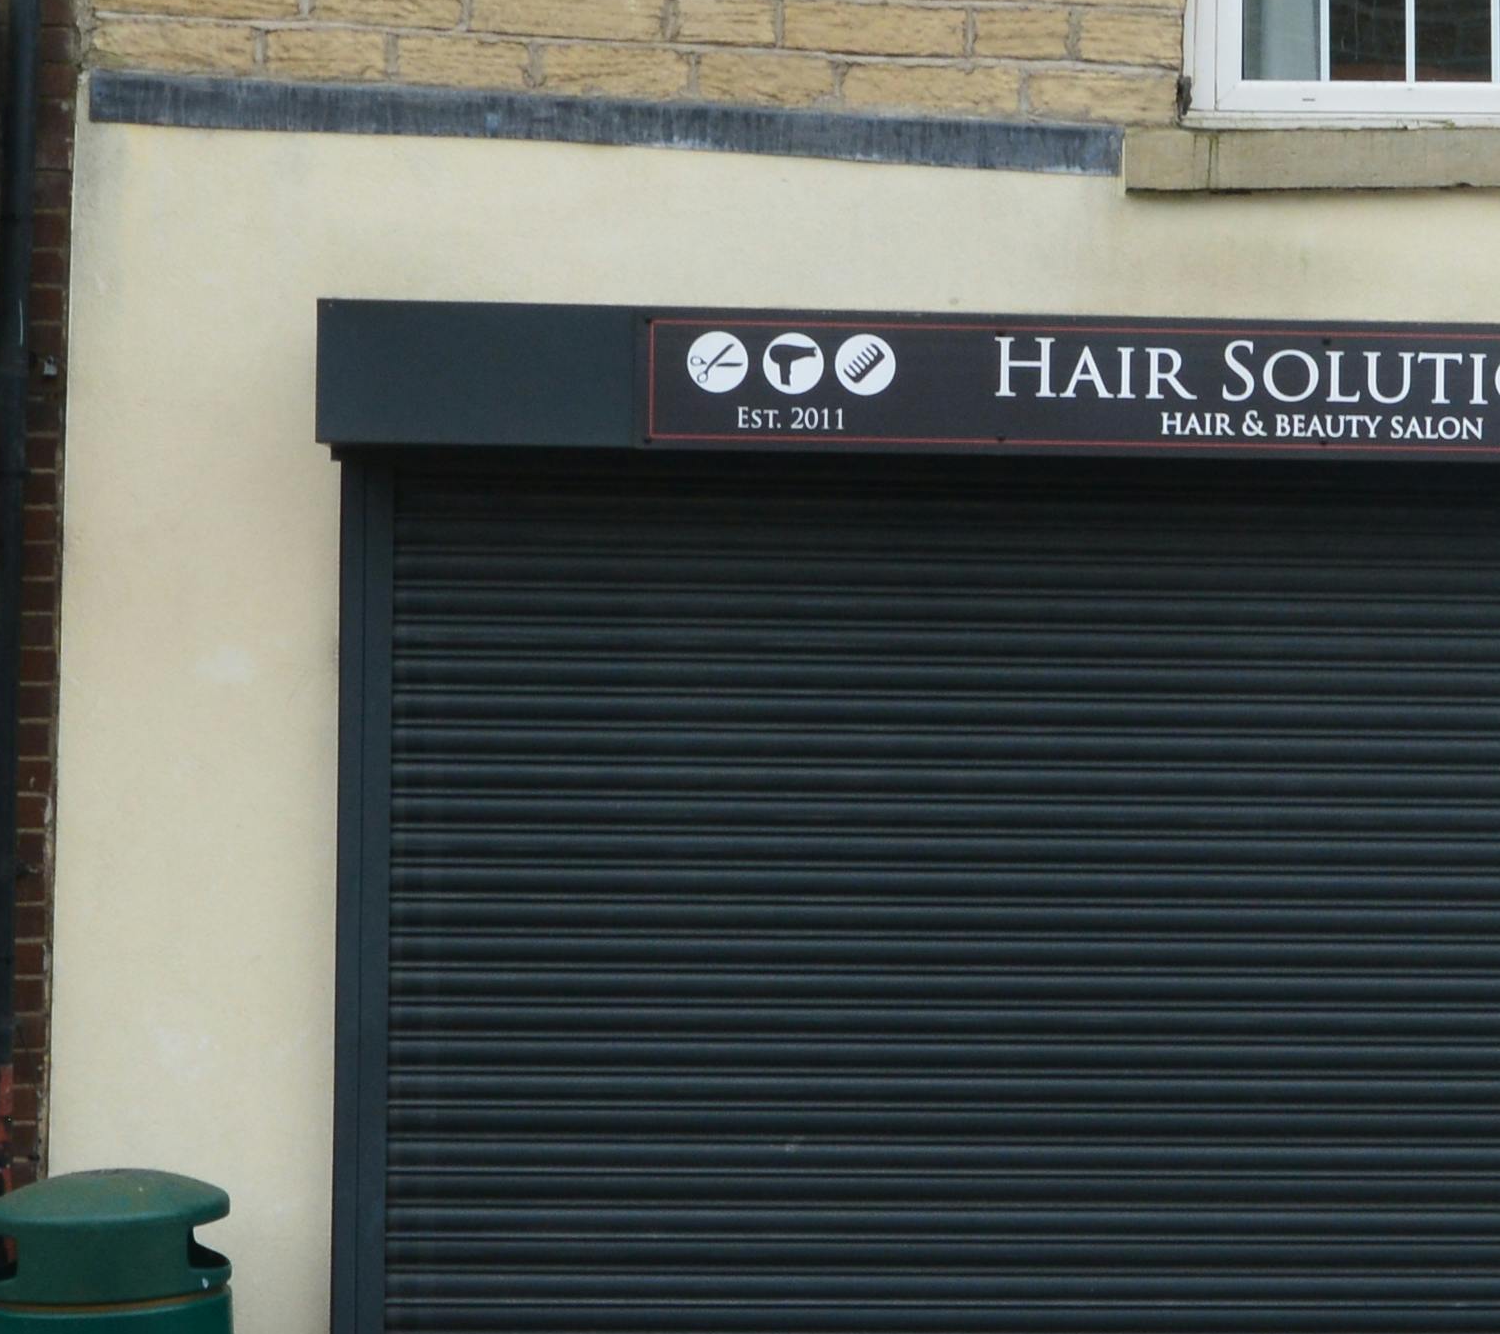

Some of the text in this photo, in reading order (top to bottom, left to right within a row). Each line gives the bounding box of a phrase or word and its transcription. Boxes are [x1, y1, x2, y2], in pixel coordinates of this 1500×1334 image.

[994, 336, 1198, 401] HAIR
[790, 407, 845, 431] 2011
[1161, 411, 1484, 441] HAIR & BEAUTY SALON
